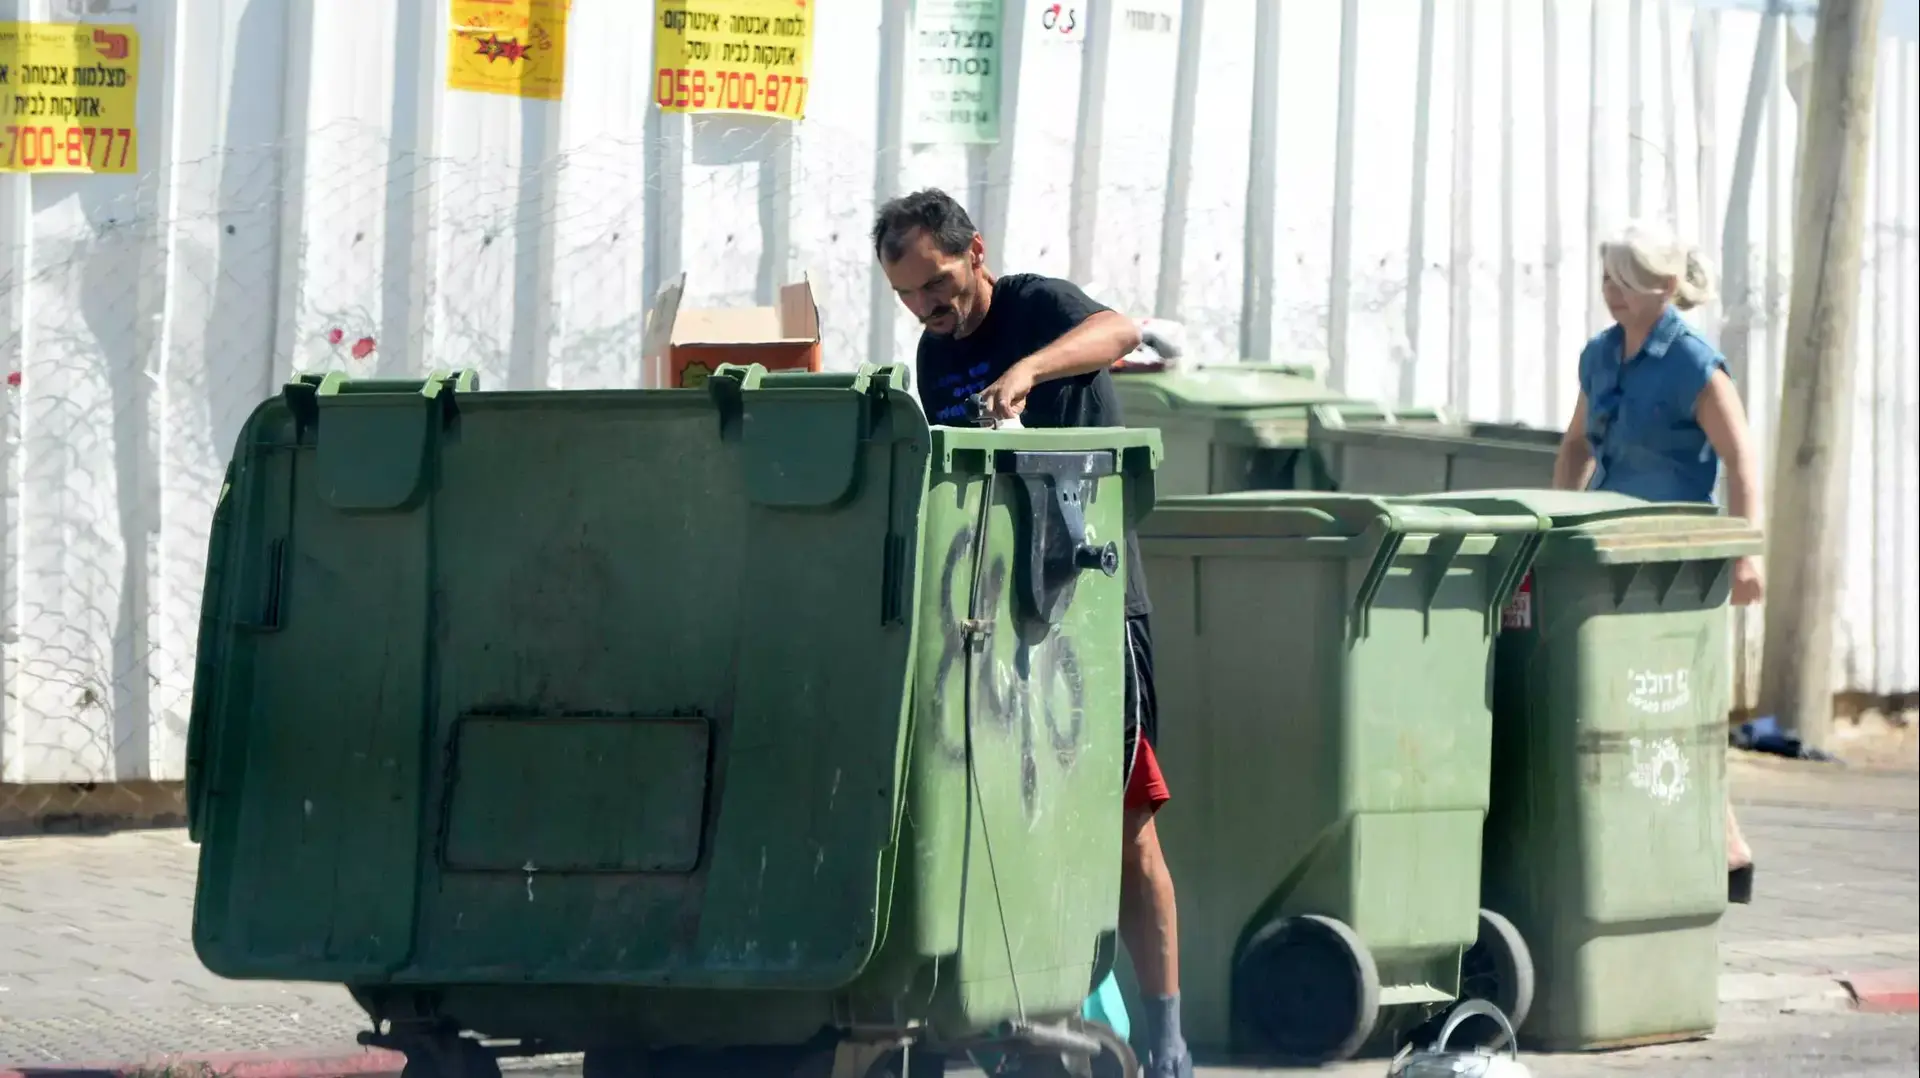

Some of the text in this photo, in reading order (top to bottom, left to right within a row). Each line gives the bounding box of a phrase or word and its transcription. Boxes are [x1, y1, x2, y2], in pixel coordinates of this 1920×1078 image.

[729, 15, 770, 34] אבטחה
[919, 25, 994, 48] מצלמות
[722, 40, 751, 62] לבית
[752, 45, 797, 70] אזעקות
[21, 64, 68, 86] אבטחה
[72, 62, 126, 87] מצלמות
[918, 57, 991, 76] נסתרות
[657, 68, 809, 115] 058-700-877
[14, 92, 46, 116] לבית
[50, 96, 101, 122] אזעקות
